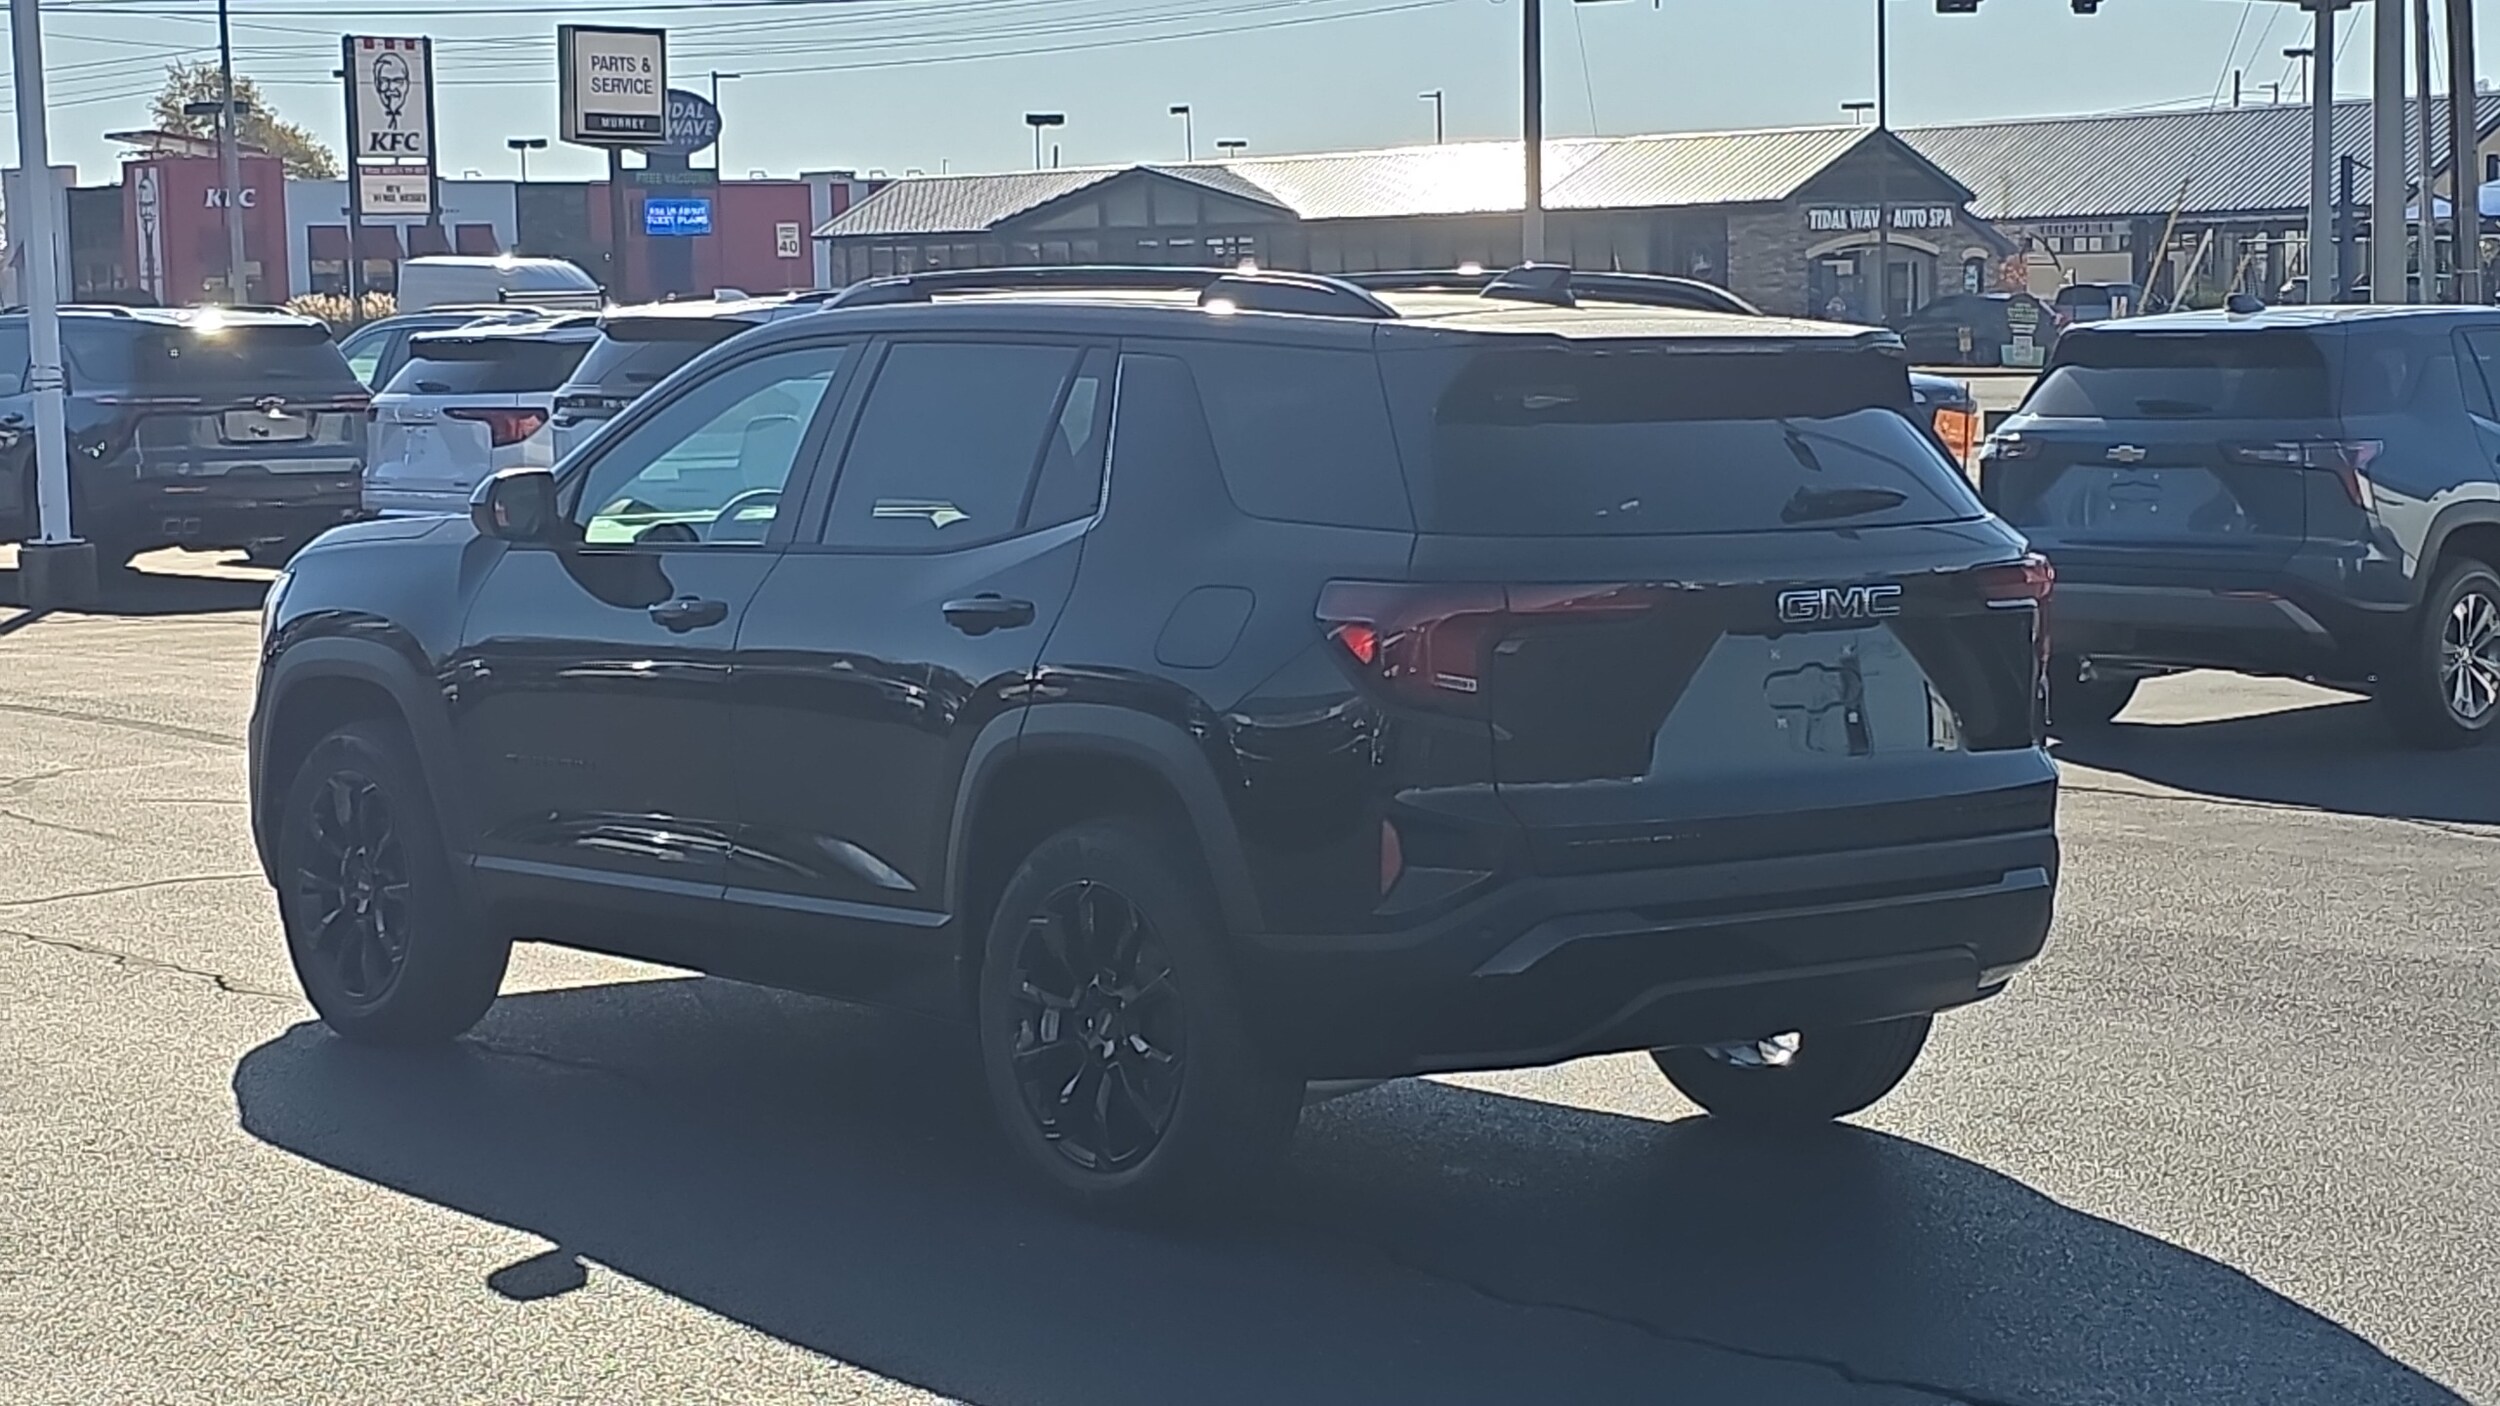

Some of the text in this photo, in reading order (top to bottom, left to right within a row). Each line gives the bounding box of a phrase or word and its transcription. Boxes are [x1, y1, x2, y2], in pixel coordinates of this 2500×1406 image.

[591, 55, 650, 73] PARTS &
[590, 76, 653, 94] SERVICE
[670, 102, 705, 119] DAL
[670, 119, 714, 136] WAVE
[369, 132, 419, 151] KFC
[1809, 207, 1953, 229] TIDAL WAV AUTO SPA
[780, 240, 798, 253] 40
[1778, 585, 1902, 623] GMC
